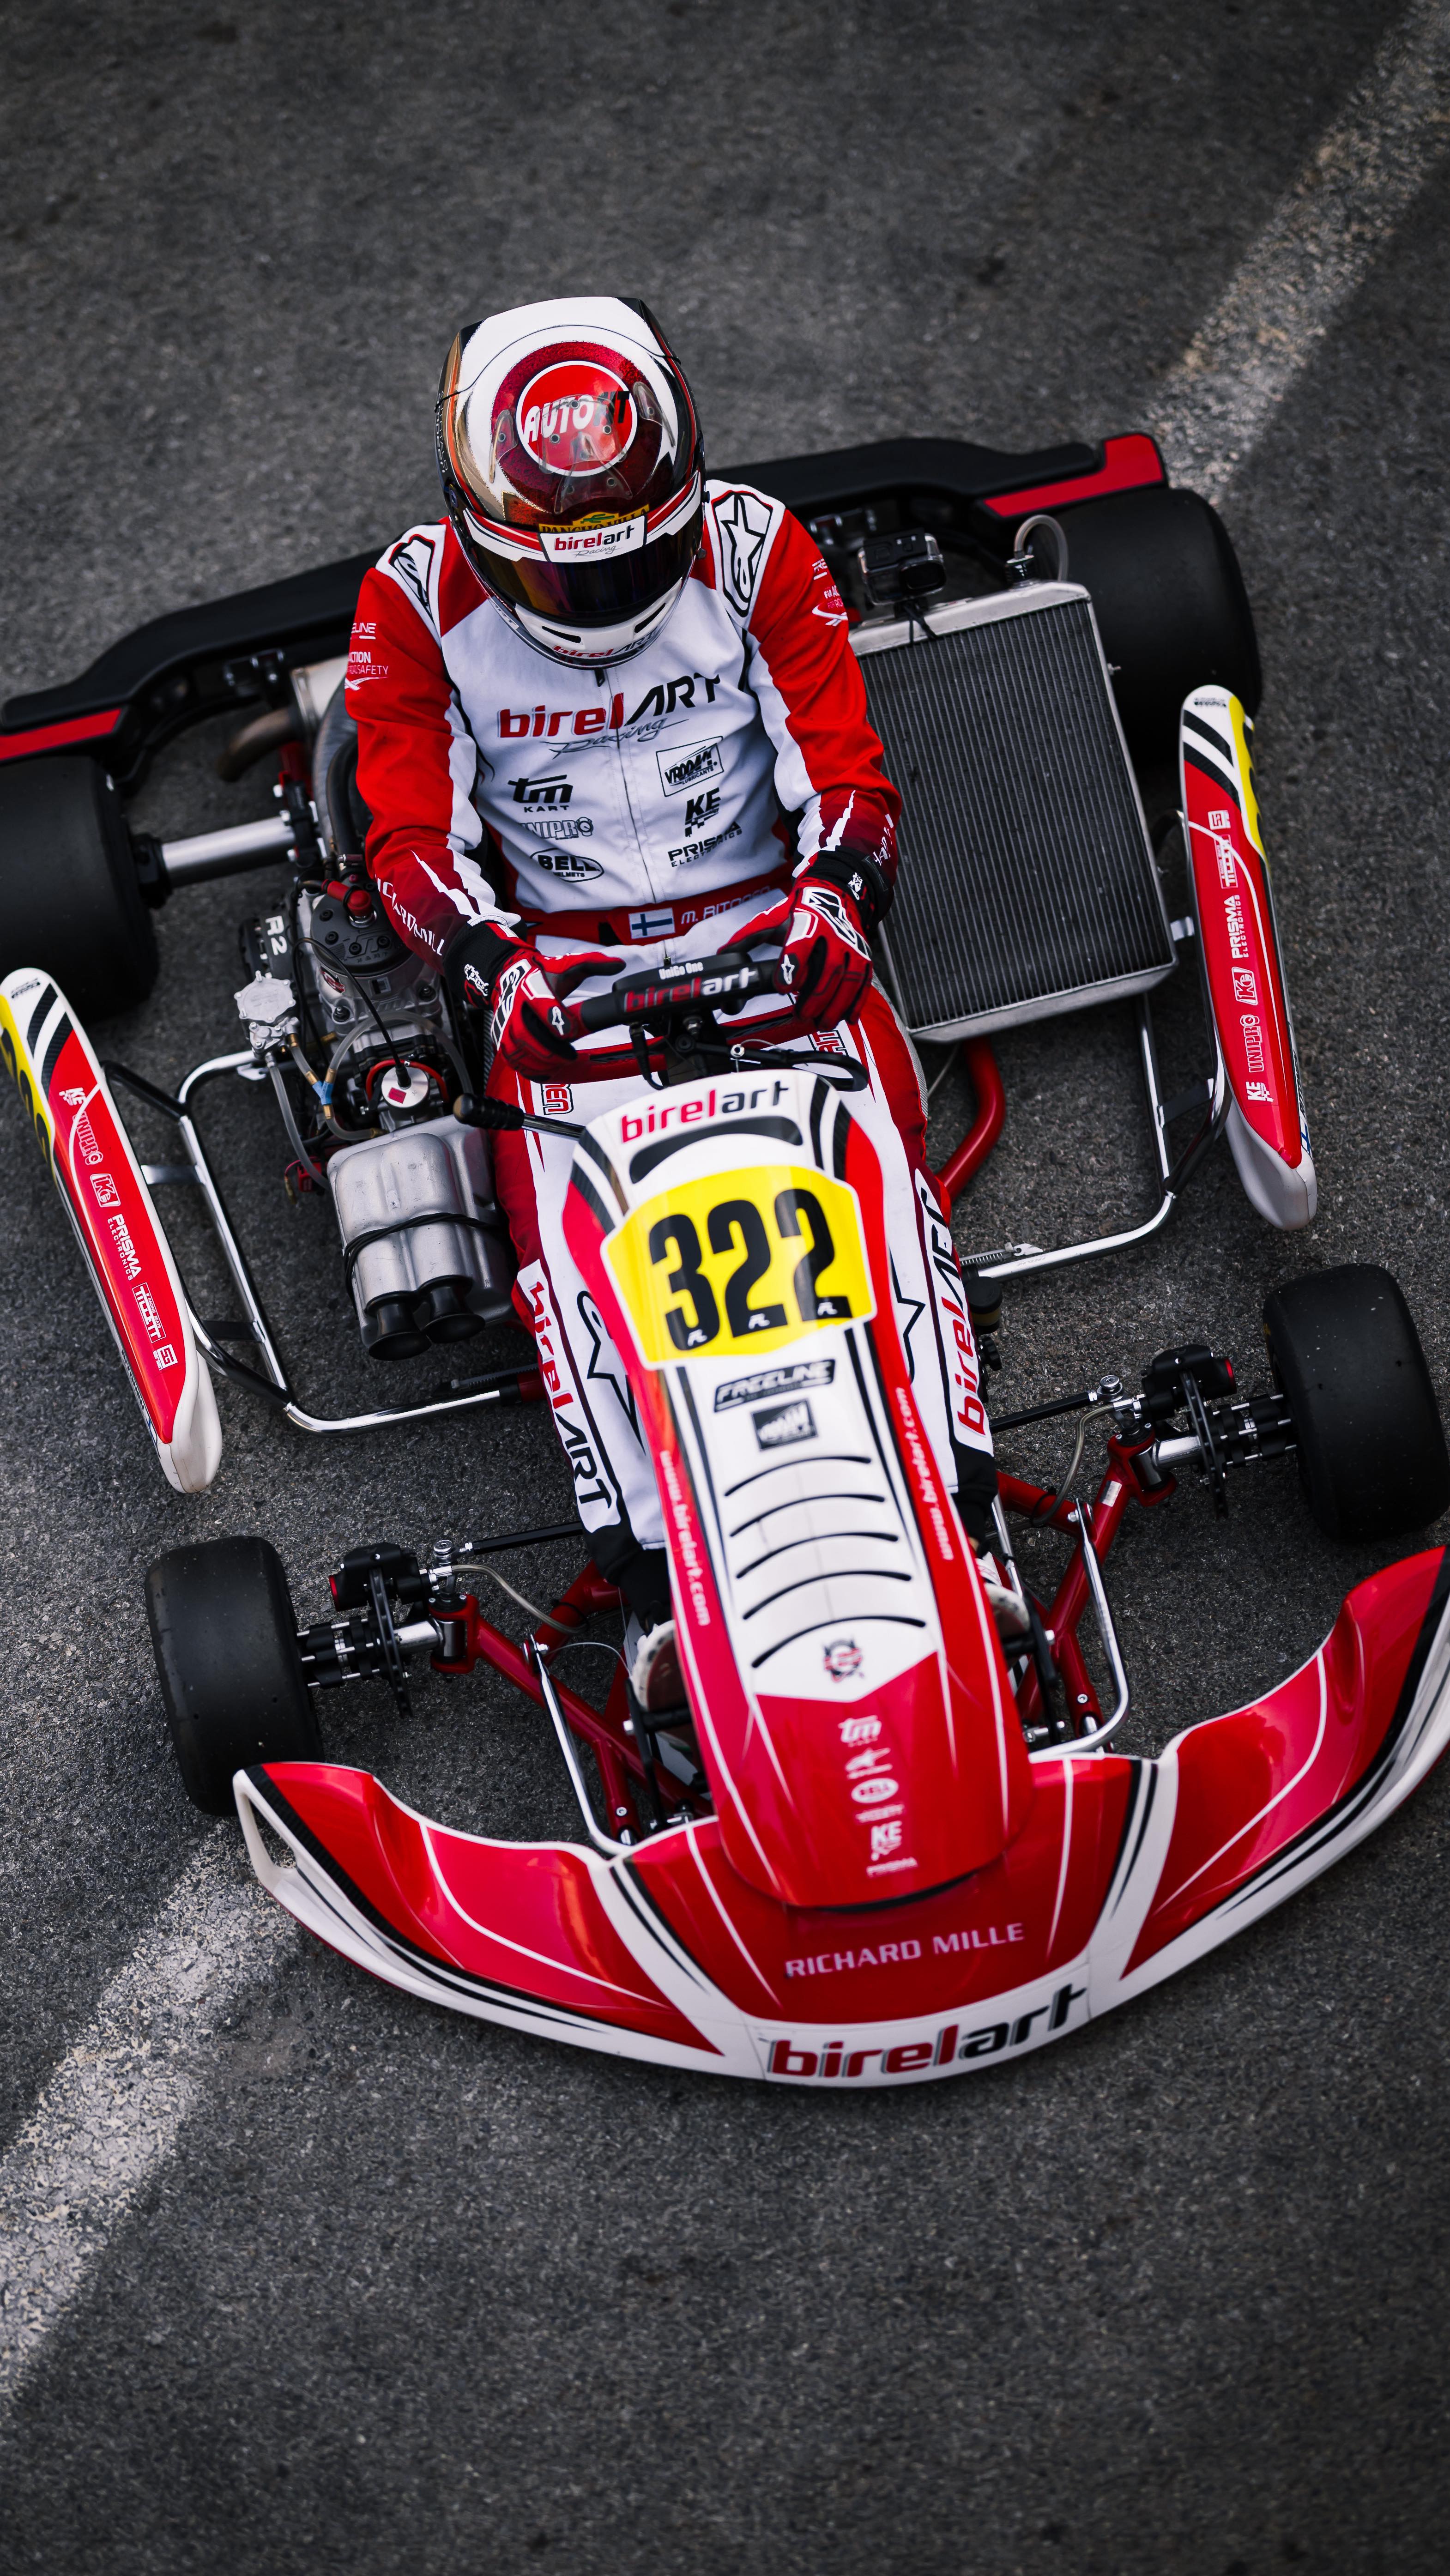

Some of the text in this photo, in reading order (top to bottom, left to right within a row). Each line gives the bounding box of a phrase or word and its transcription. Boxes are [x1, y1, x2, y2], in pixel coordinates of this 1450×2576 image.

[497, 672, 721, 738] birelART
[538, 854, 600, 871] BELL
[1224, 895, 1243, 959] PRISMA
[623, 967, 758, 1012] birelart
[685, 962, 704, 974] One
[620, 1081, 789, 1143] birelart
[108, 1218, 133, 1281] ELECTRONICS
[112, 1214, 142, 1278] PRISMA
[649, 1188, 852, 1351] 322
[659, 1450, 711, 1627] www.birelart.com
[785, 1923, 1025, 1977] RICHARD MILLE
[767, 1983, 1087, 2079] birelart
